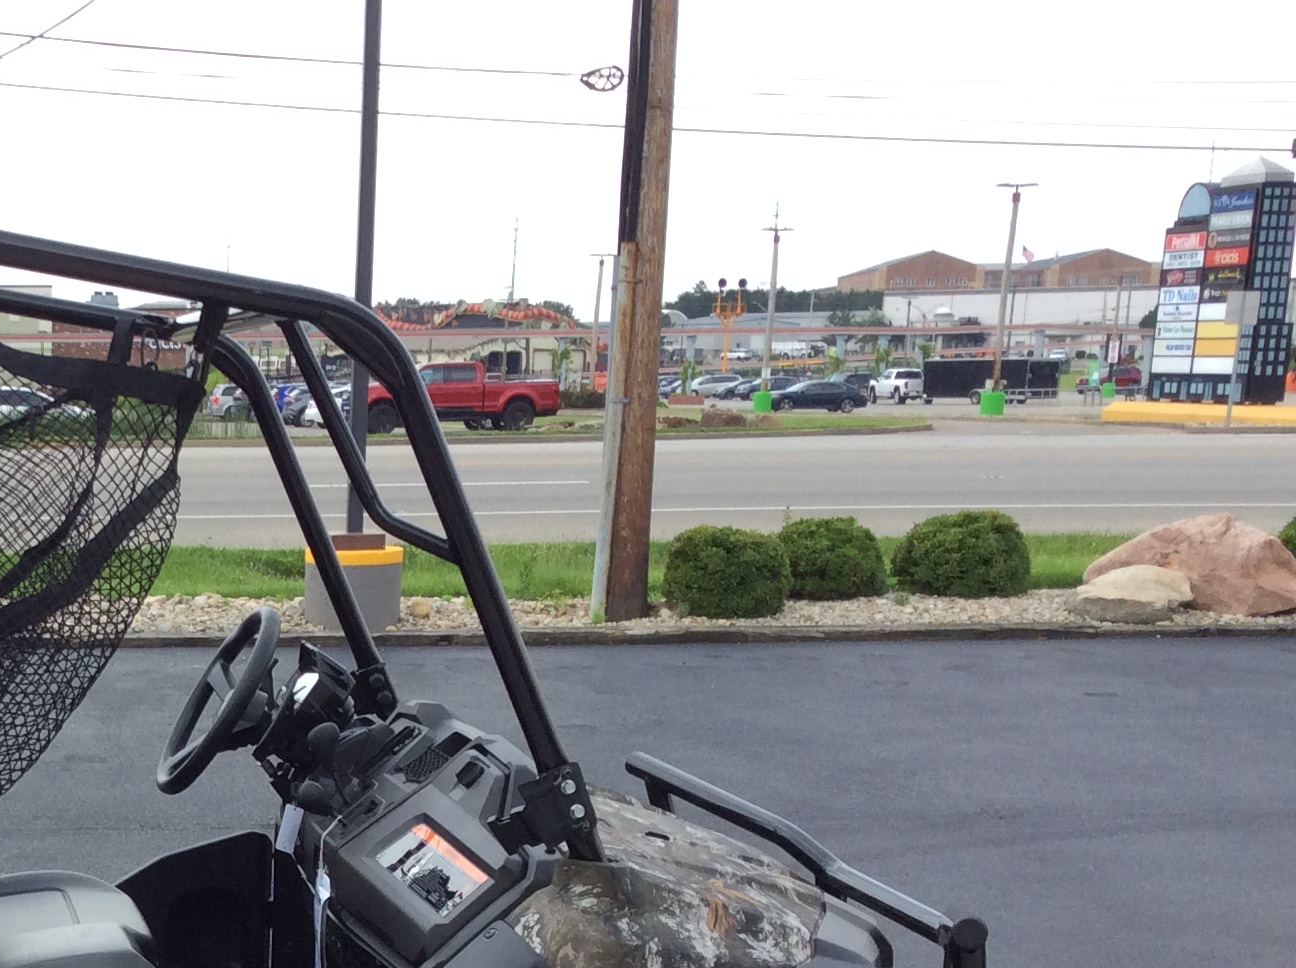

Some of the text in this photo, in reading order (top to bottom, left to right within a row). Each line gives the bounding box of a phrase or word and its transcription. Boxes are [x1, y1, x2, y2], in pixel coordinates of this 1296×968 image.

[1169, 252, 1199, 261] DENTIST
[1162, 290, 1175, 302] TD
[1177, 288, 1198, 301] Nails
